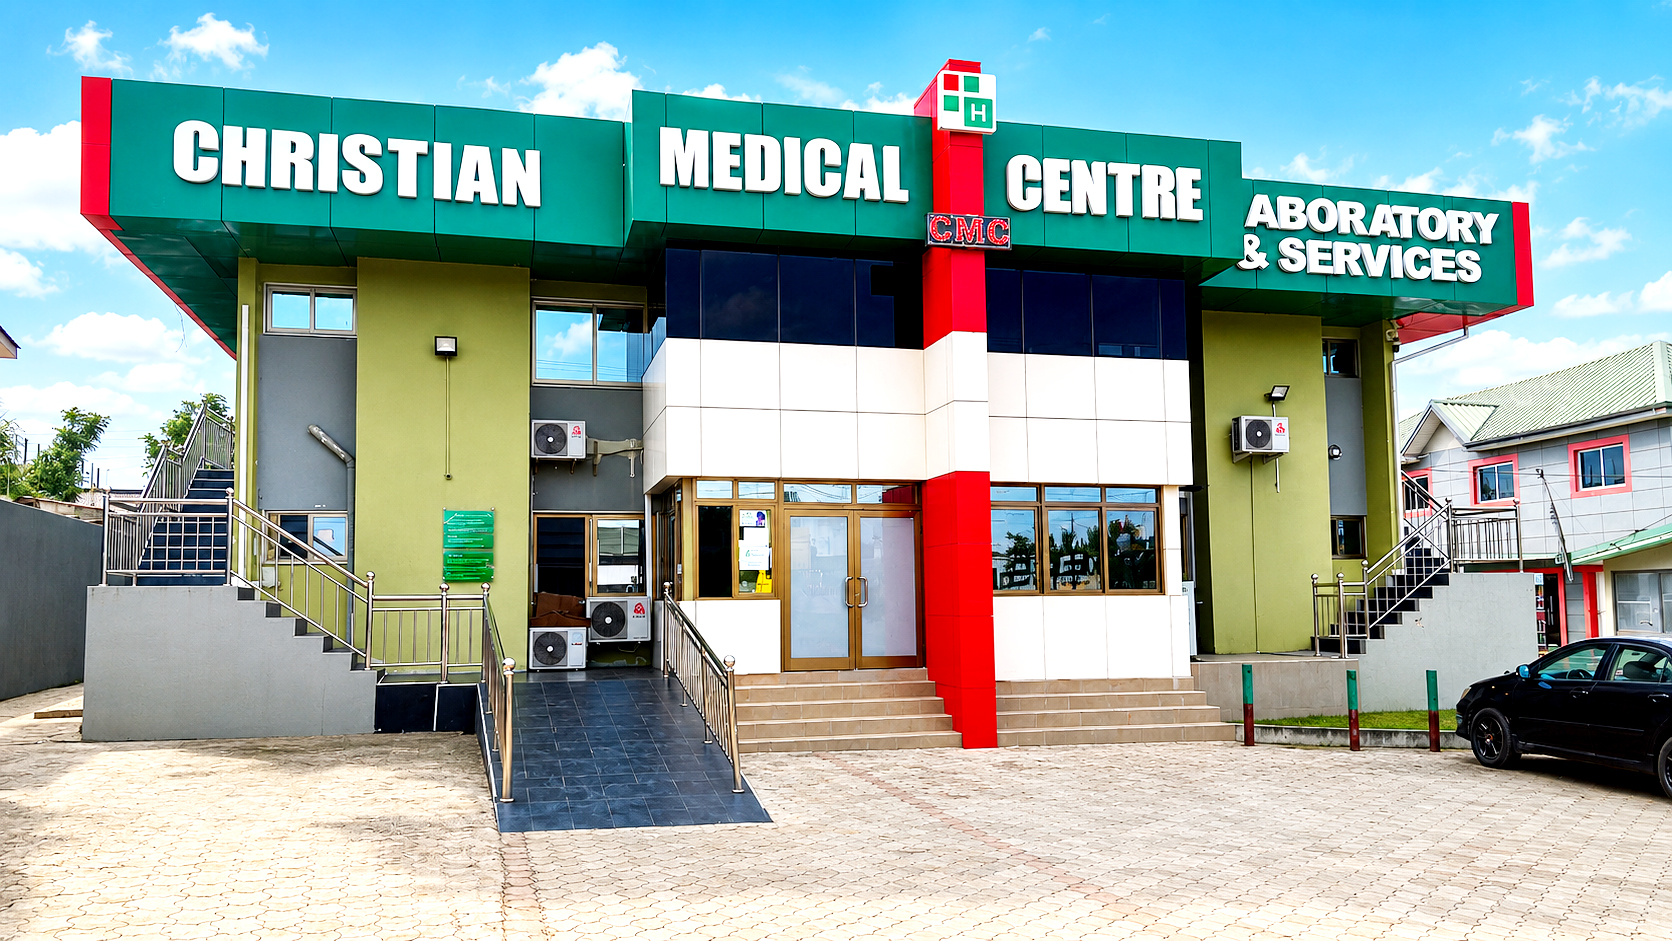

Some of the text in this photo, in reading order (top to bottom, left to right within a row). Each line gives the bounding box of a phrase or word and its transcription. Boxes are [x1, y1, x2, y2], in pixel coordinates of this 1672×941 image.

[970, 103, 987, 123] H
[172, 119, 1205, 222] CHRISTIAN MEDICAL CENTRE
[929, 215, 1010, 246] CMC
[1243, 193, 1501, 245] ABORATORY
[1236, 233, 1483, 284] & SERVICES
